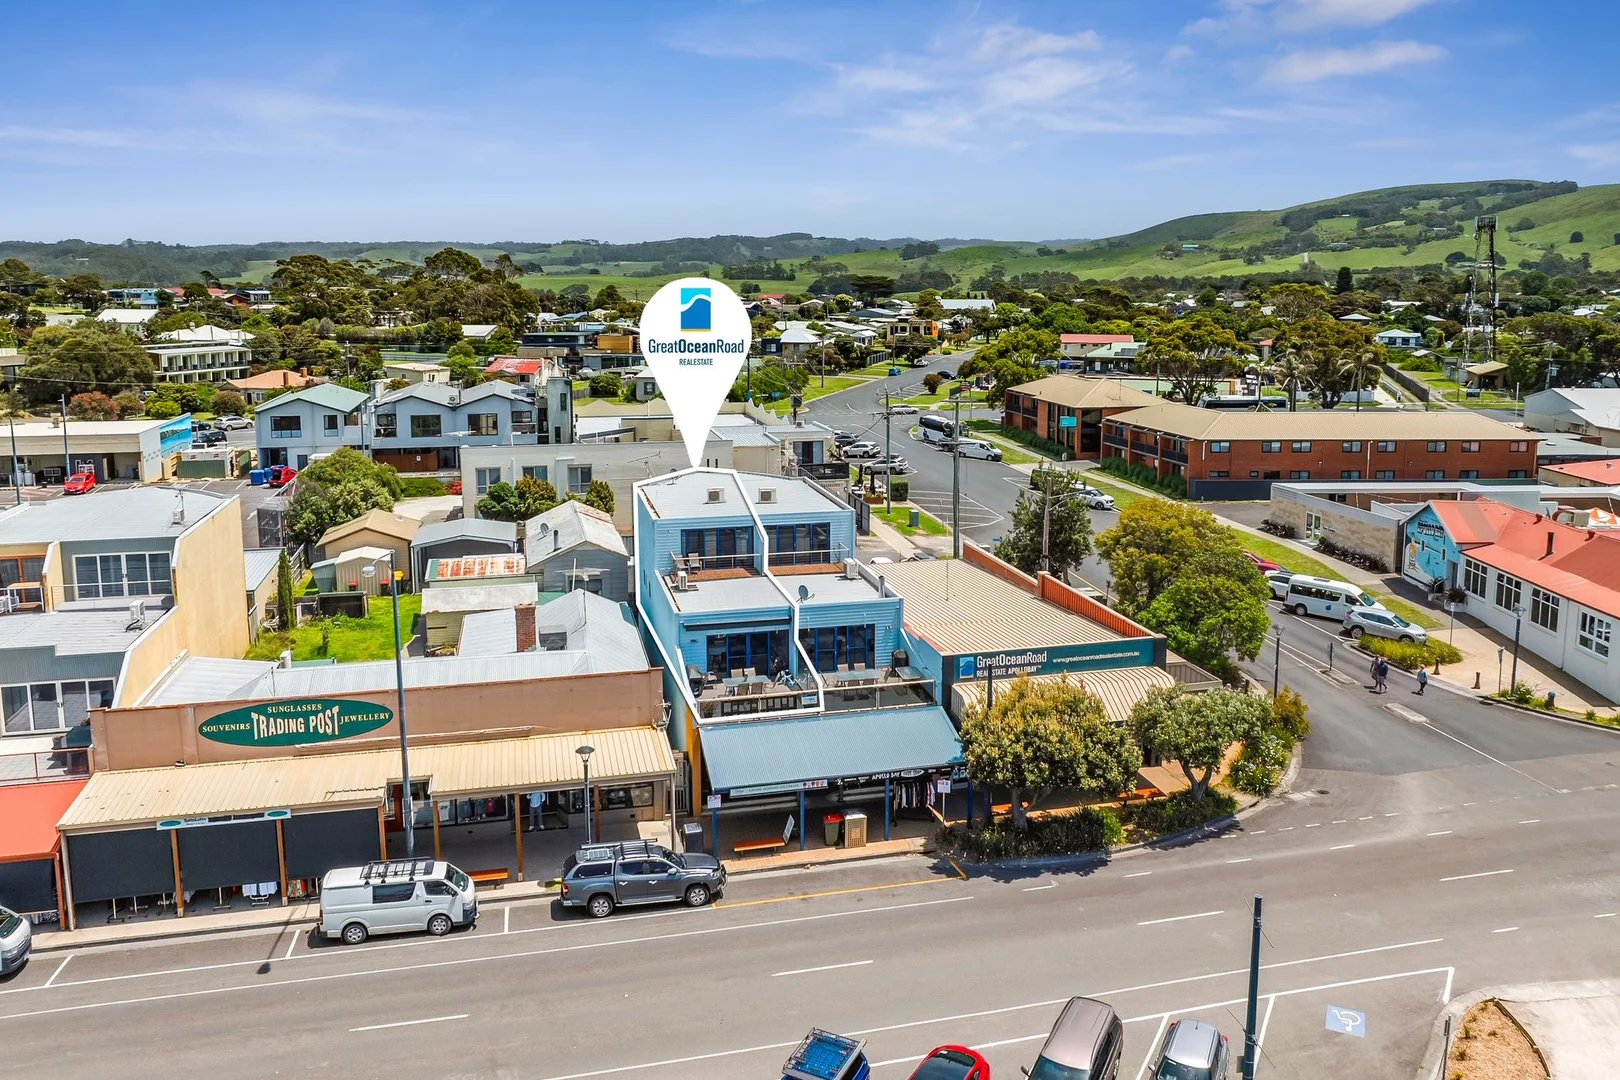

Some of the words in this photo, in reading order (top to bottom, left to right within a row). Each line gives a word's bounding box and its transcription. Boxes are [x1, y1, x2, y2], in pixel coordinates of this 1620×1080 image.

[267, 703, 322, 713] SUNGLASSES
[251, 711, 305, 740] TRADING
[309, 705, 341, 736] POST
[339, 712, 390, 725] JEWELLERY
[202, 723, 251, 733] SOUVENIRS
